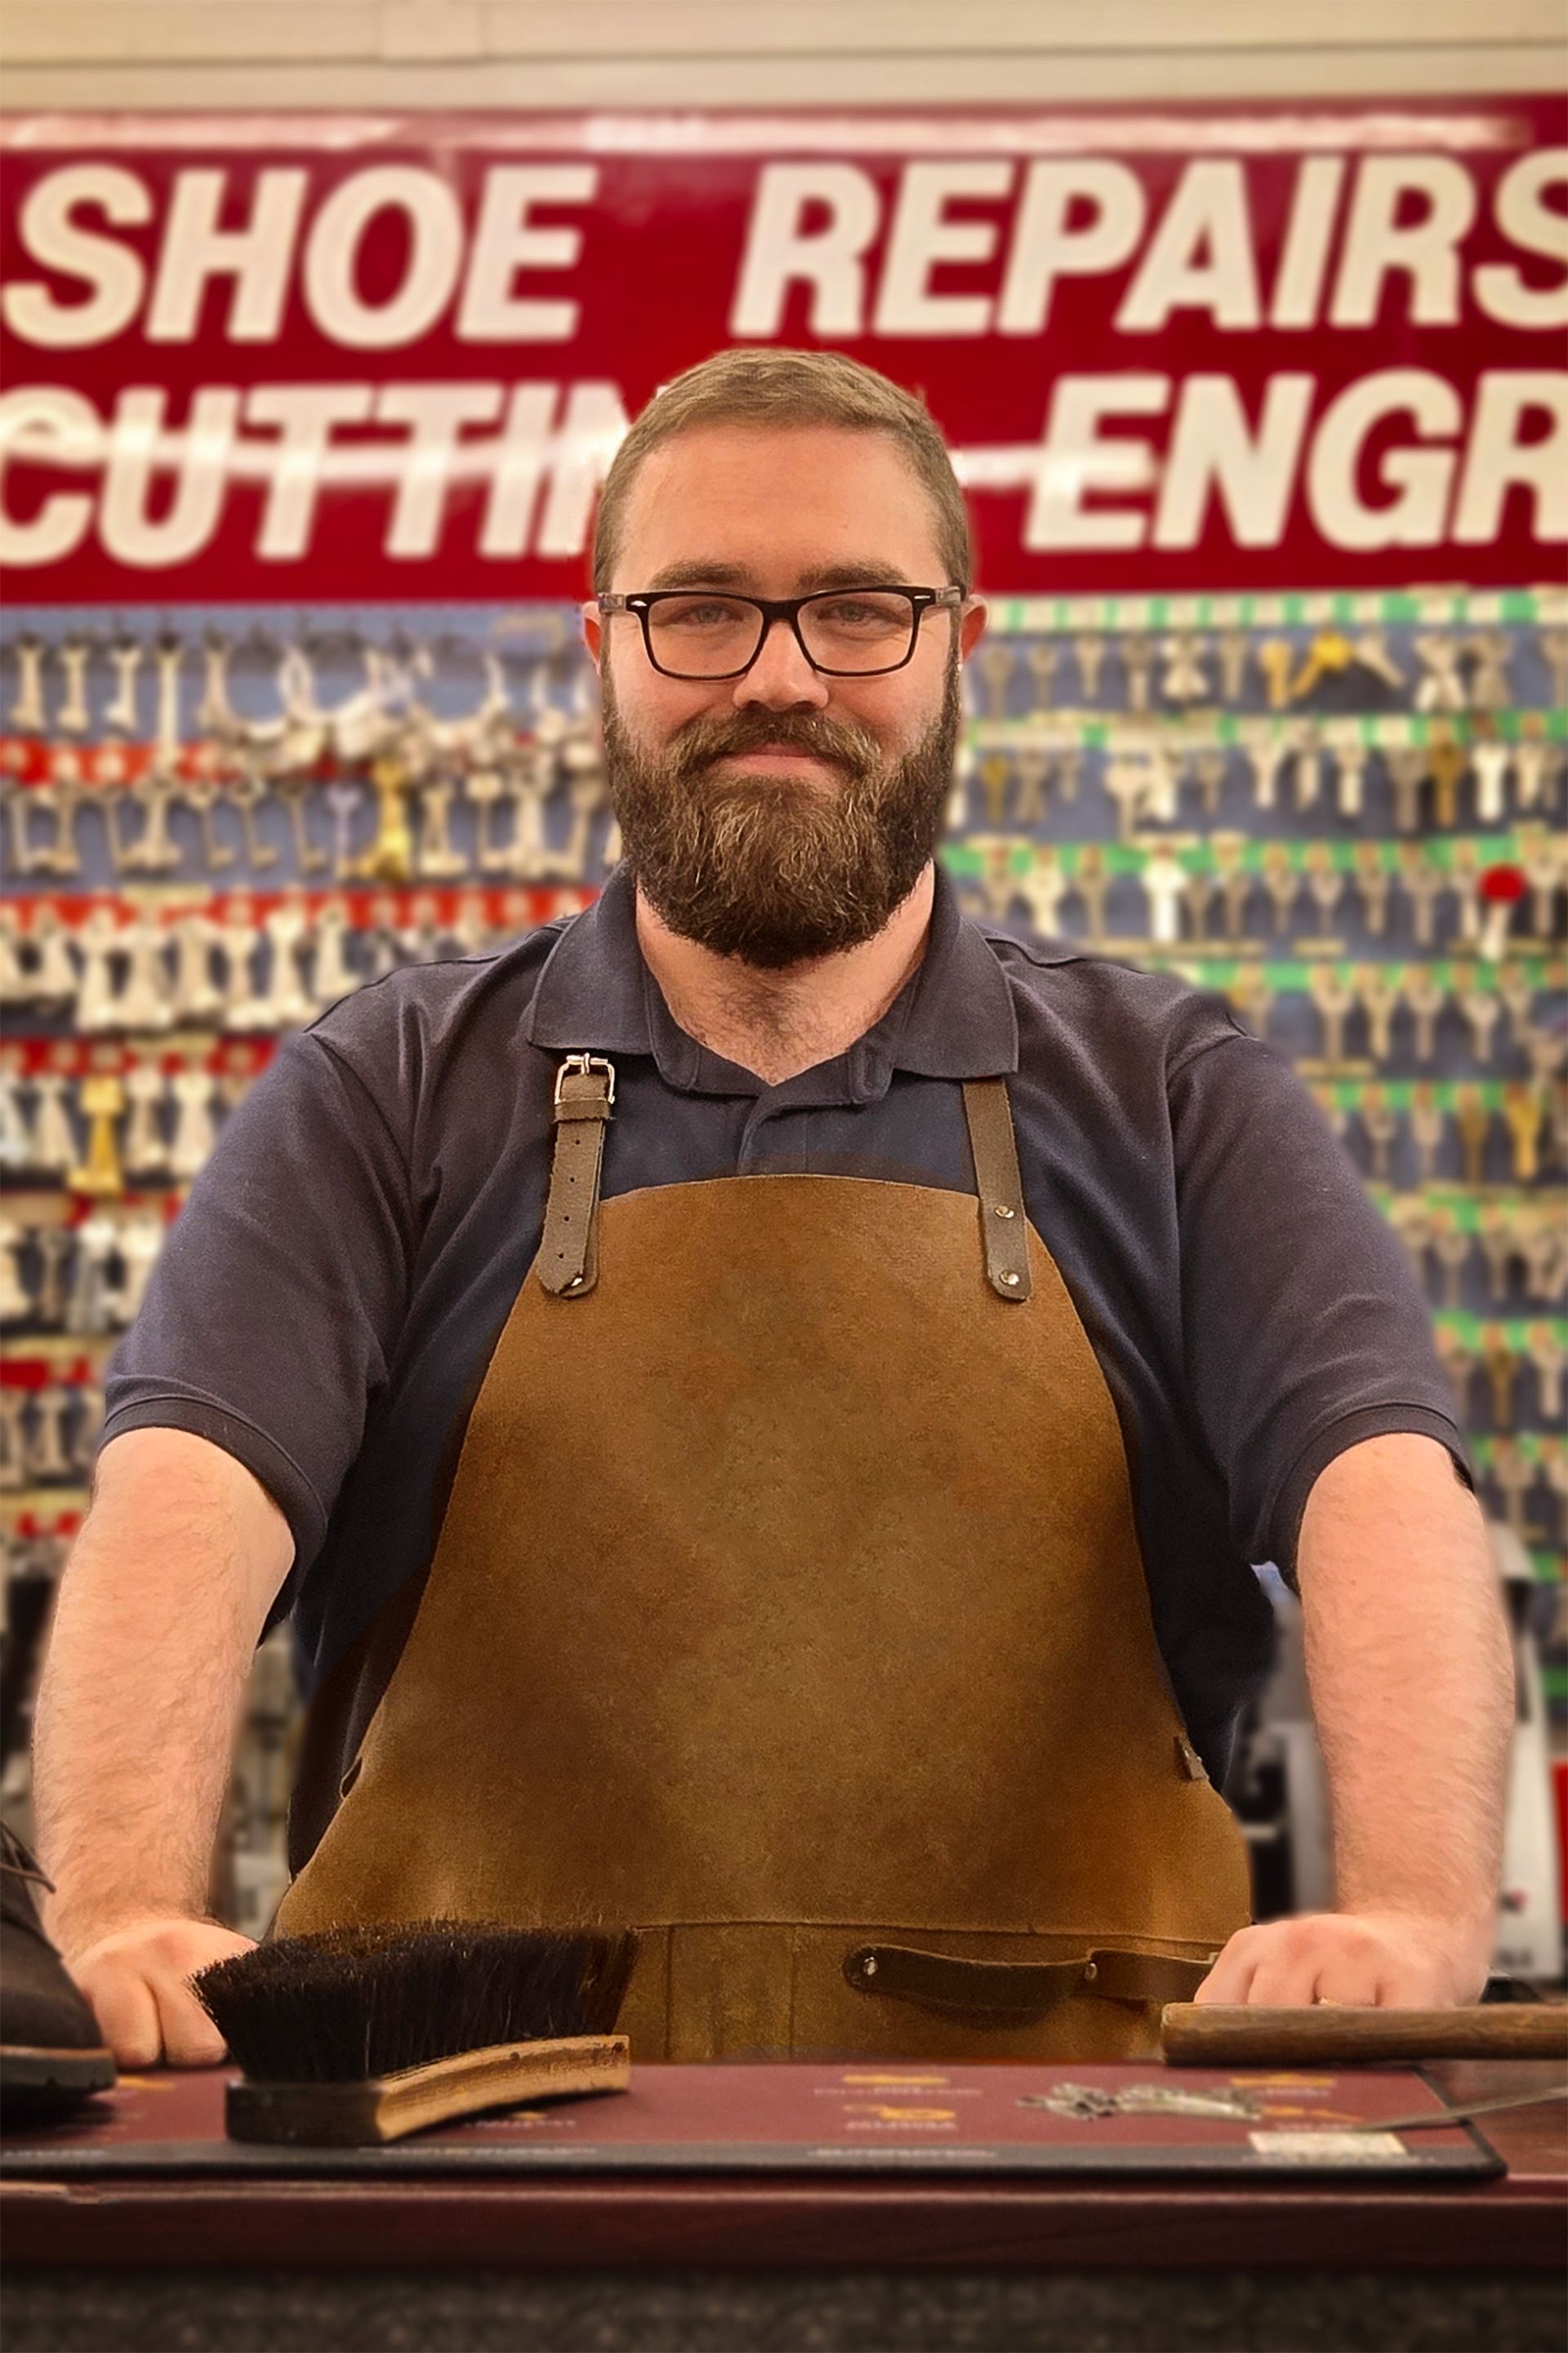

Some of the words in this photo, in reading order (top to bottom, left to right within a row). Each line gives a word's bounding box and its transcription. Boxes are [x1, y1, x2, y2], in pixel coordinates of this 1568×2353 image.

[2, 163, 599, 348] SHOE
[729, 149, 1568, 338] REPAIRS
[1024, 369, 1568, 550] ENGR
